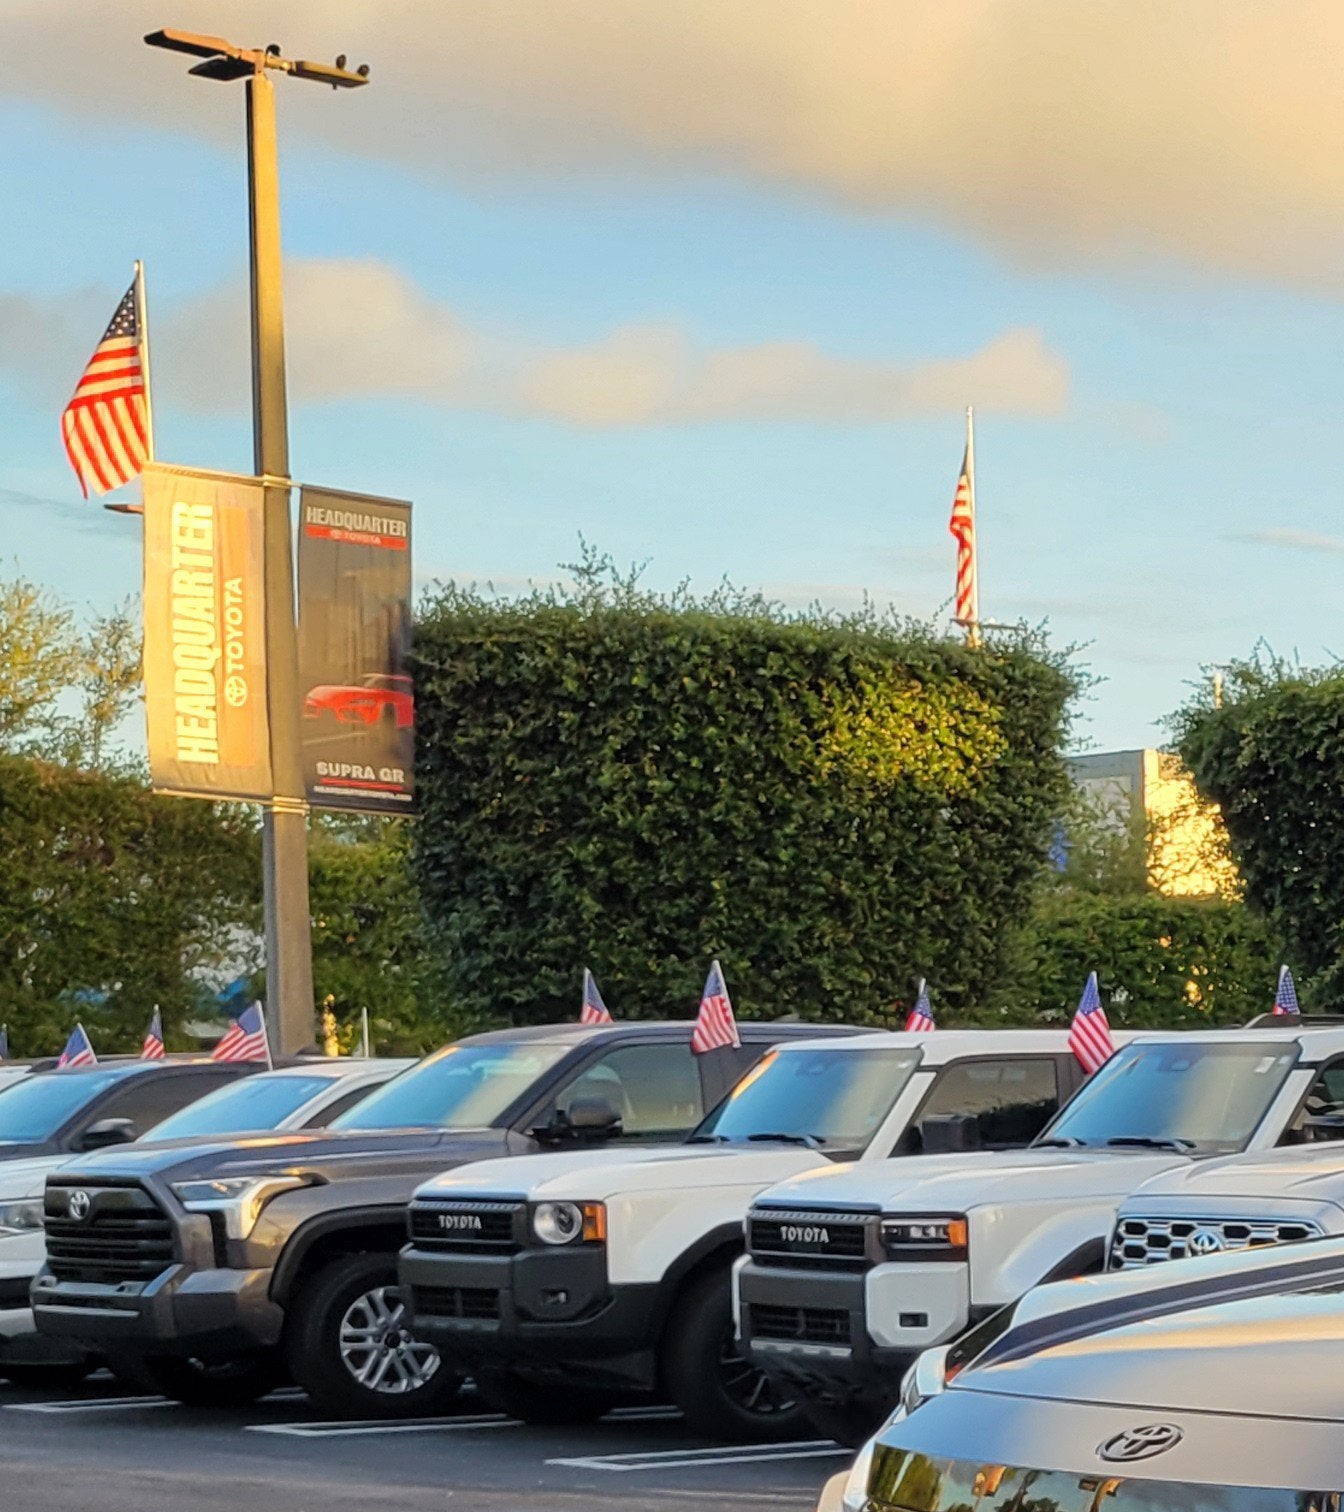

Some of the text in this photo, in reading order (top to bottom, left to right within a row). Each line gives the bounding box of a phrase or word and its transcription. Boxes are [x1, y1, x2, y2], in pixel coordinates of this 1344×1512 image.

[306, 506, 407, 537] HEADQUARTER
[171, 500, 221, 764] HEADQUARTER
[224, 577, 245, 674] TOYOTA
[315, 761, 405, 783] SUPRA GR
[438, 1214, 482, 1229] TOYOTA
[780, 1225, 830, 1243] TOYOTA
